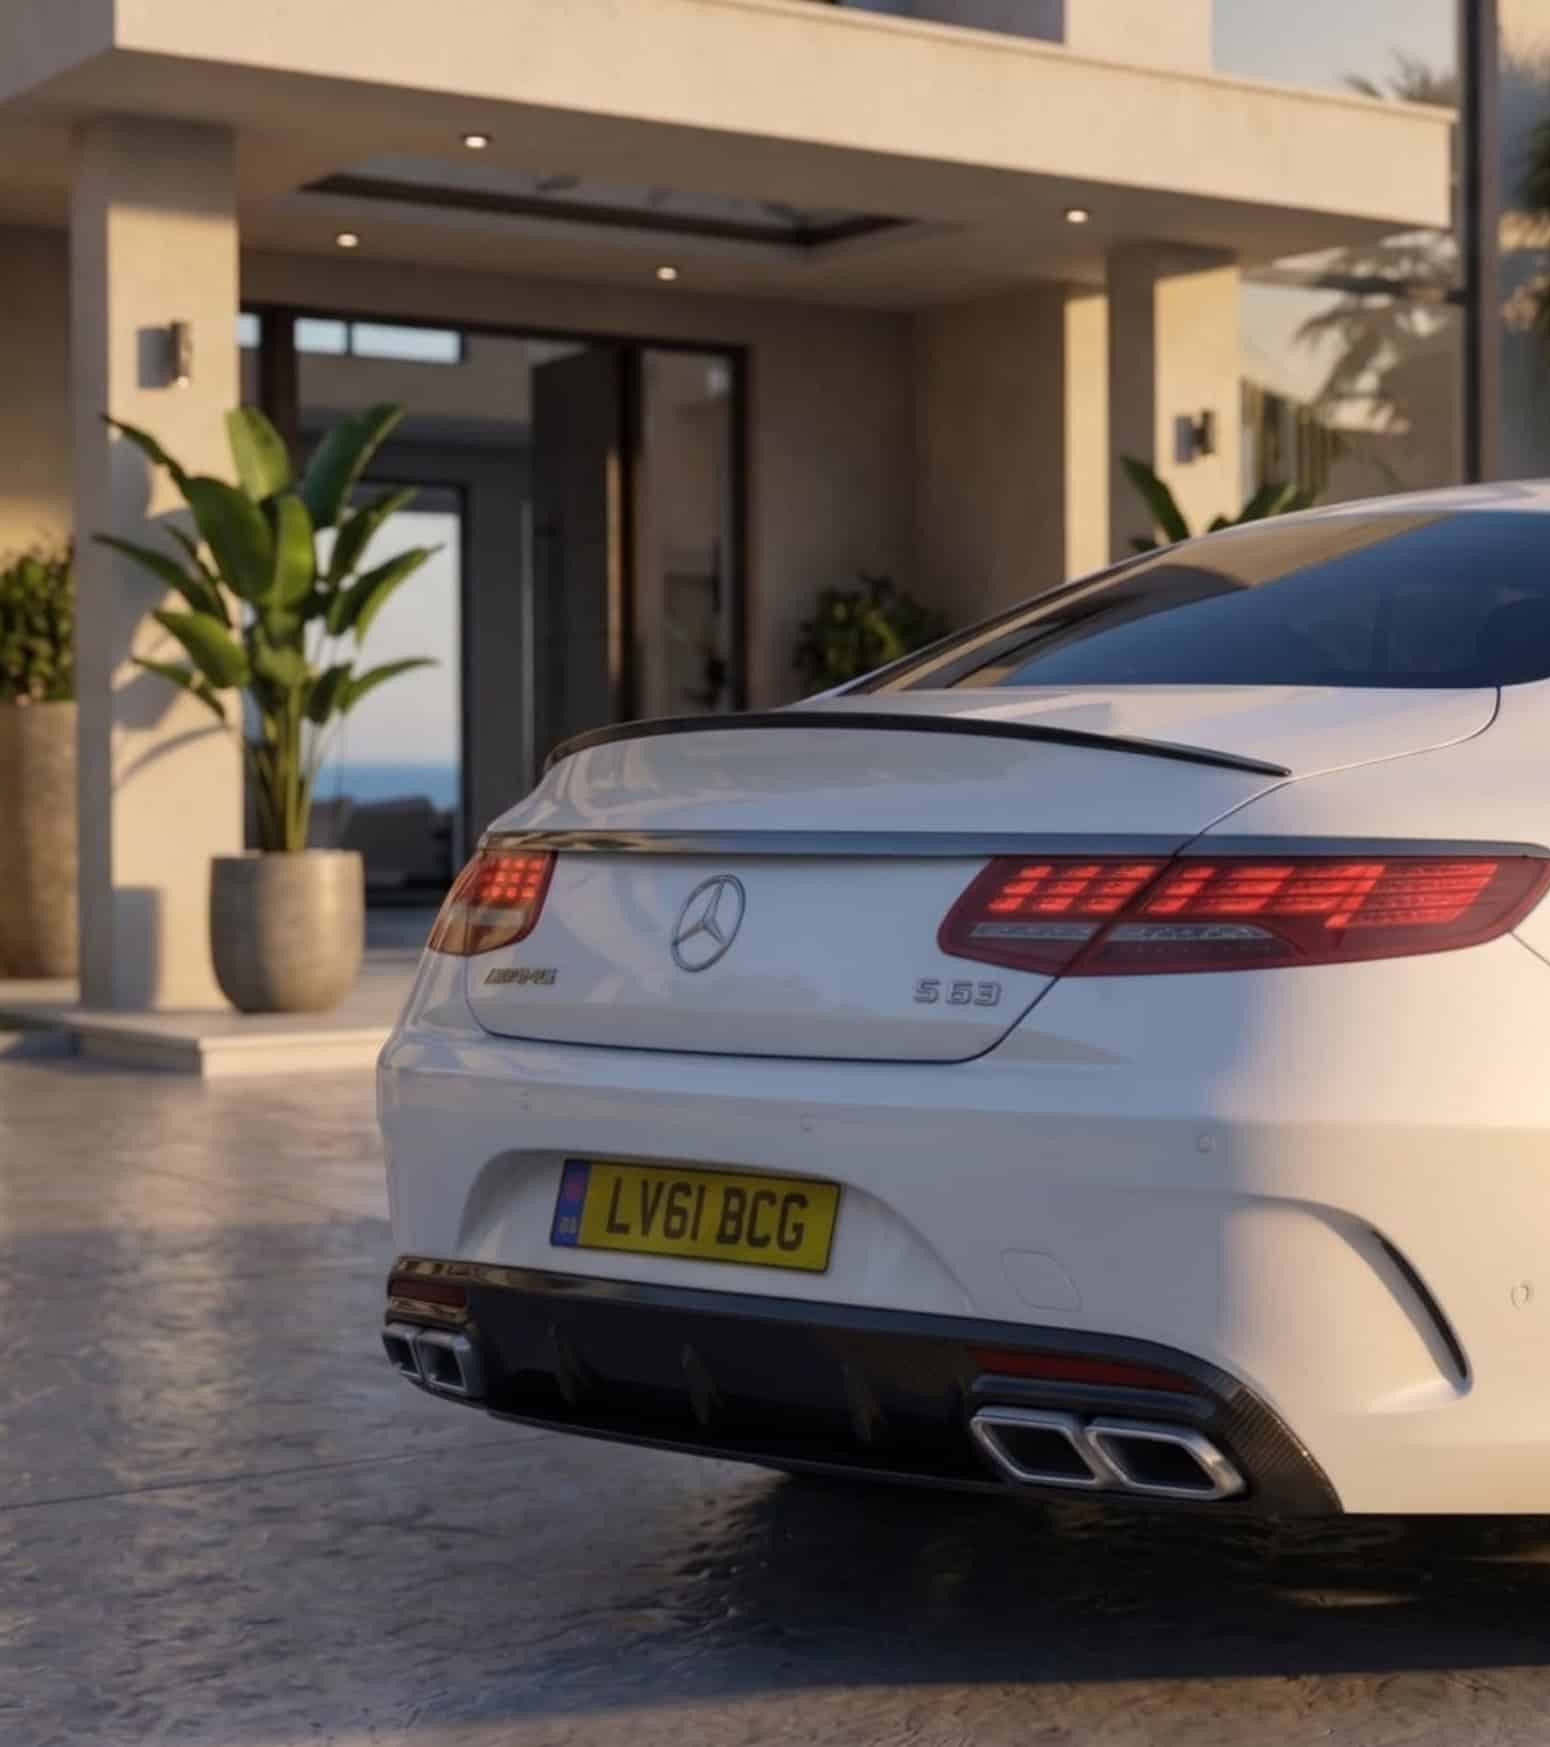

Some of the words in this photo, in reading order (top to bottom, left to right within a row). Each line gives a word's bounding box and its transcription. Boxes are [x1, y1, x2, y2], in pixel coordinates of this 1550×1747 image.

[913, 979, 941, 1004] S
[945, 980, 1002, 1006] 63
[606, 1177, 704, 1240] LV61
[716, 1187, 808, 1251] BCG
